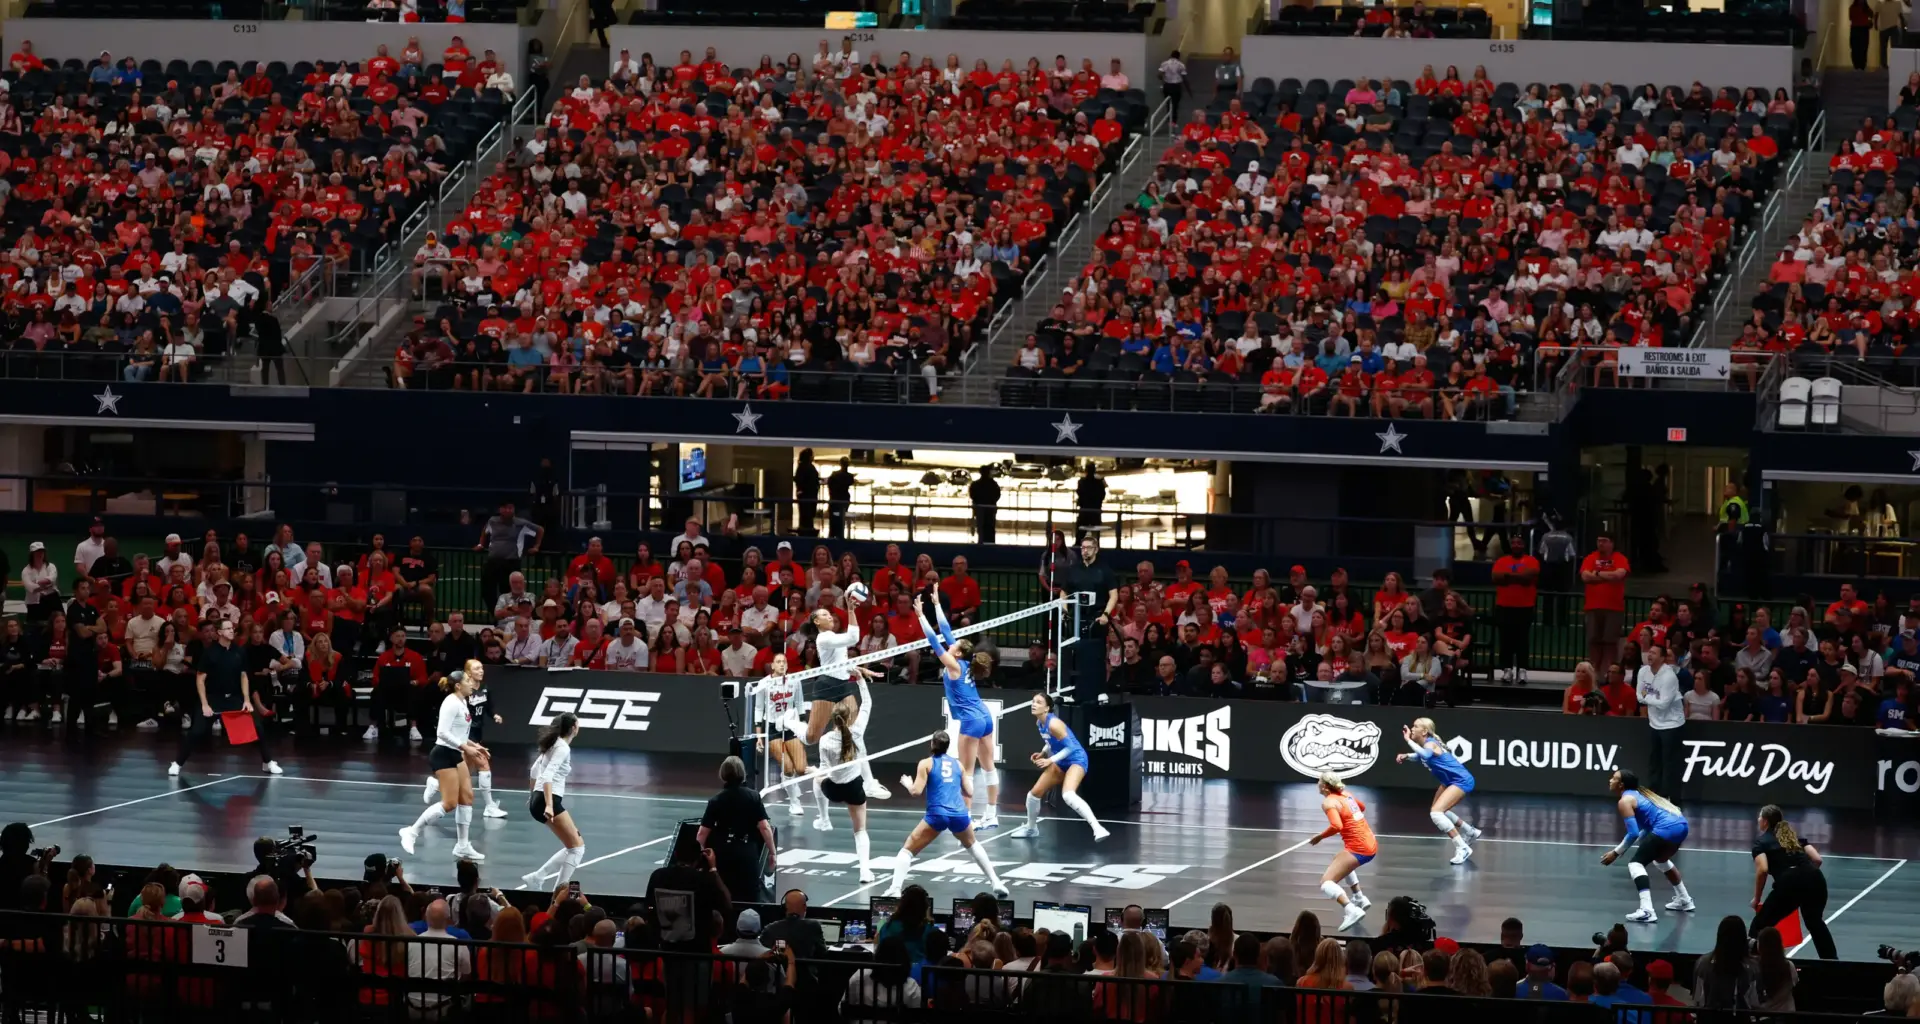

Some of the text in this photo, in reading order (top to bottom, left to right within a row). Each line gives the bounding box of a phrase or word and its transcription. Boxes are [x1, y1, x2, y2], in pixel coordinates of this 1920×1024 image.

[233, 24, 257, 33] C133
[850, 33, 875, 42] C134
[1489, 44, 1515, 53] C135
[1527, 262, 1540, 274] N
[1644, 351, 1684, 362] RESTROOMS
[1691, 353, 1707, 363] EXIT
[1645, 362, 1669, 375] BAÑOS
[1676, 366, 1701, 376] SALIDA
[528, 687, 661, 731] GSE
[775, 702, 788, 712] 27
[1887, 708, 1906, 720] SM
[1089, 721, 1126, 746] SPIKES
[1141, 705, 1231, 771] IKES
[1480, 738, 1619, 772] LIQUID I.V.
[941, 761, 953, 778] 5
[1148, 761, 1166, 773] THE
[1169, 762, 1204, 775] LIGHTS
[1681, 740, 1835, 795] Full Day
[777, 847, 1191, 890] PIKES
[777, 867, 848, 877] DER
[215, 939, 226, 963] 3
